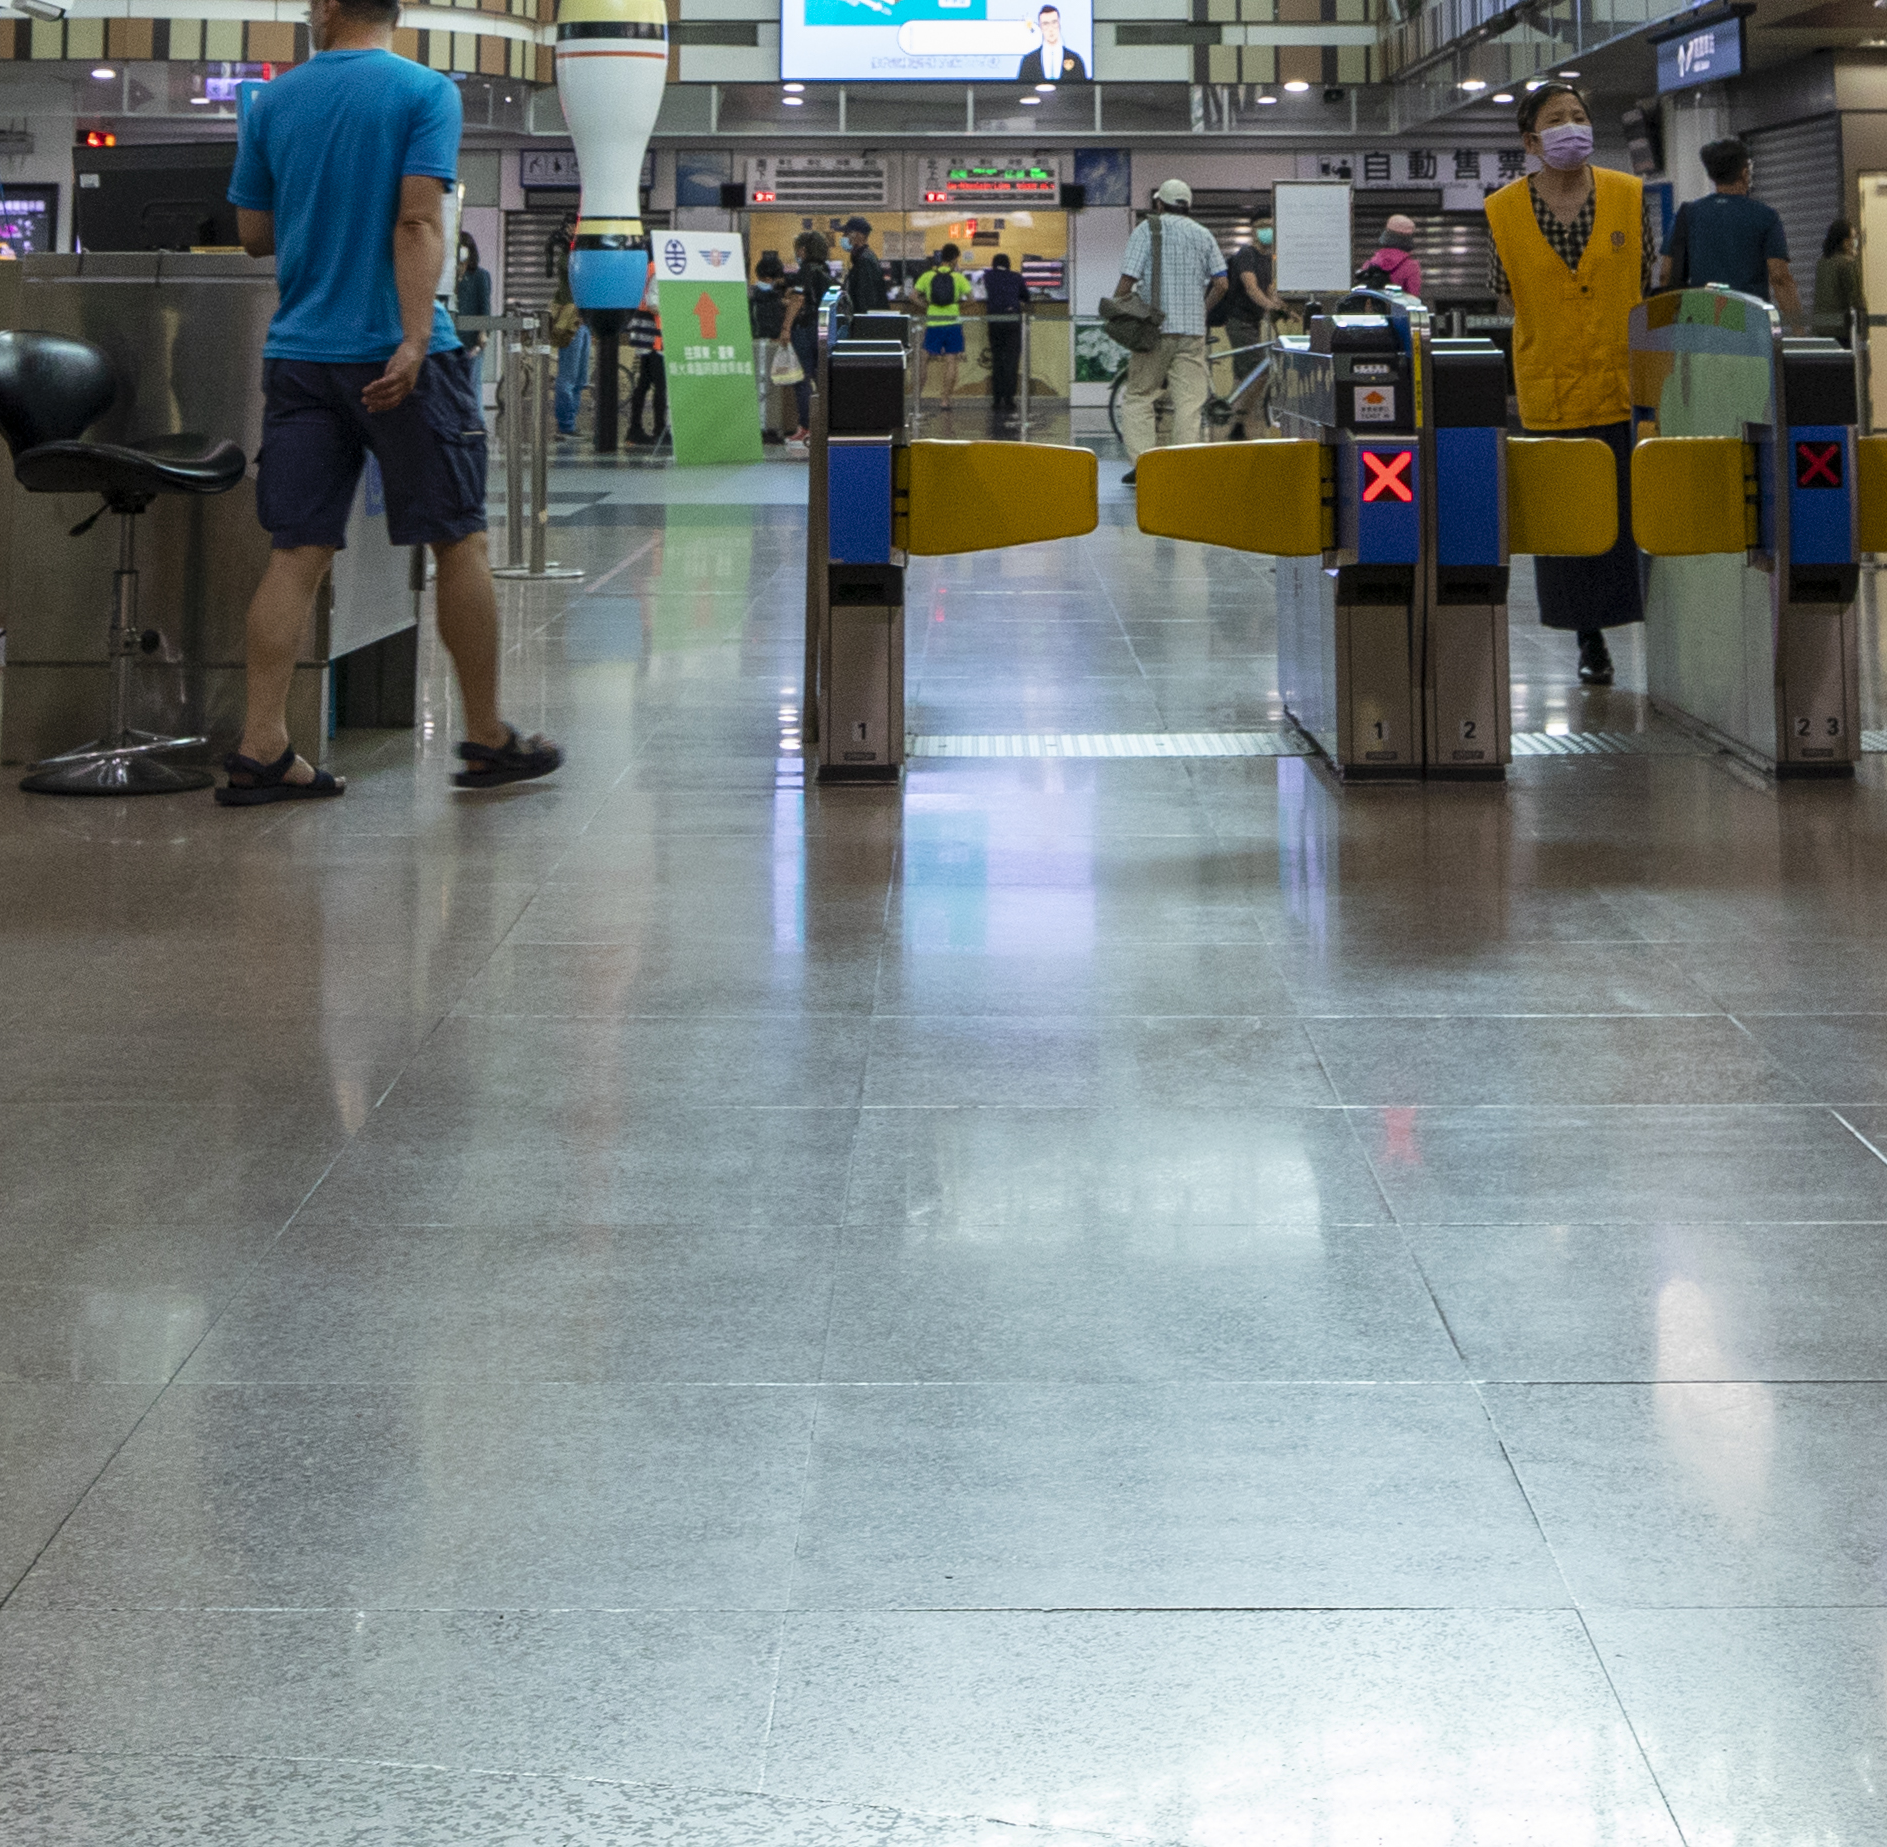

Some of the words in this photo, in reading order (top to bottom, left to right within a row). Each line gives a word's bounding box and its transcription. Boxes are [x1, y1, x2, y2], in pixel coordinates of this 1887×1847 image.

[1365, 150, 1526, 181] 自動售票
[857, 723, 868, 740] 1
[1373, 723, 1384, 740] 1
[1463, 722, 1477, 740] 2
[1798, 718, 1811, 738] 2
[1827, 718, 1839, 738] 3
